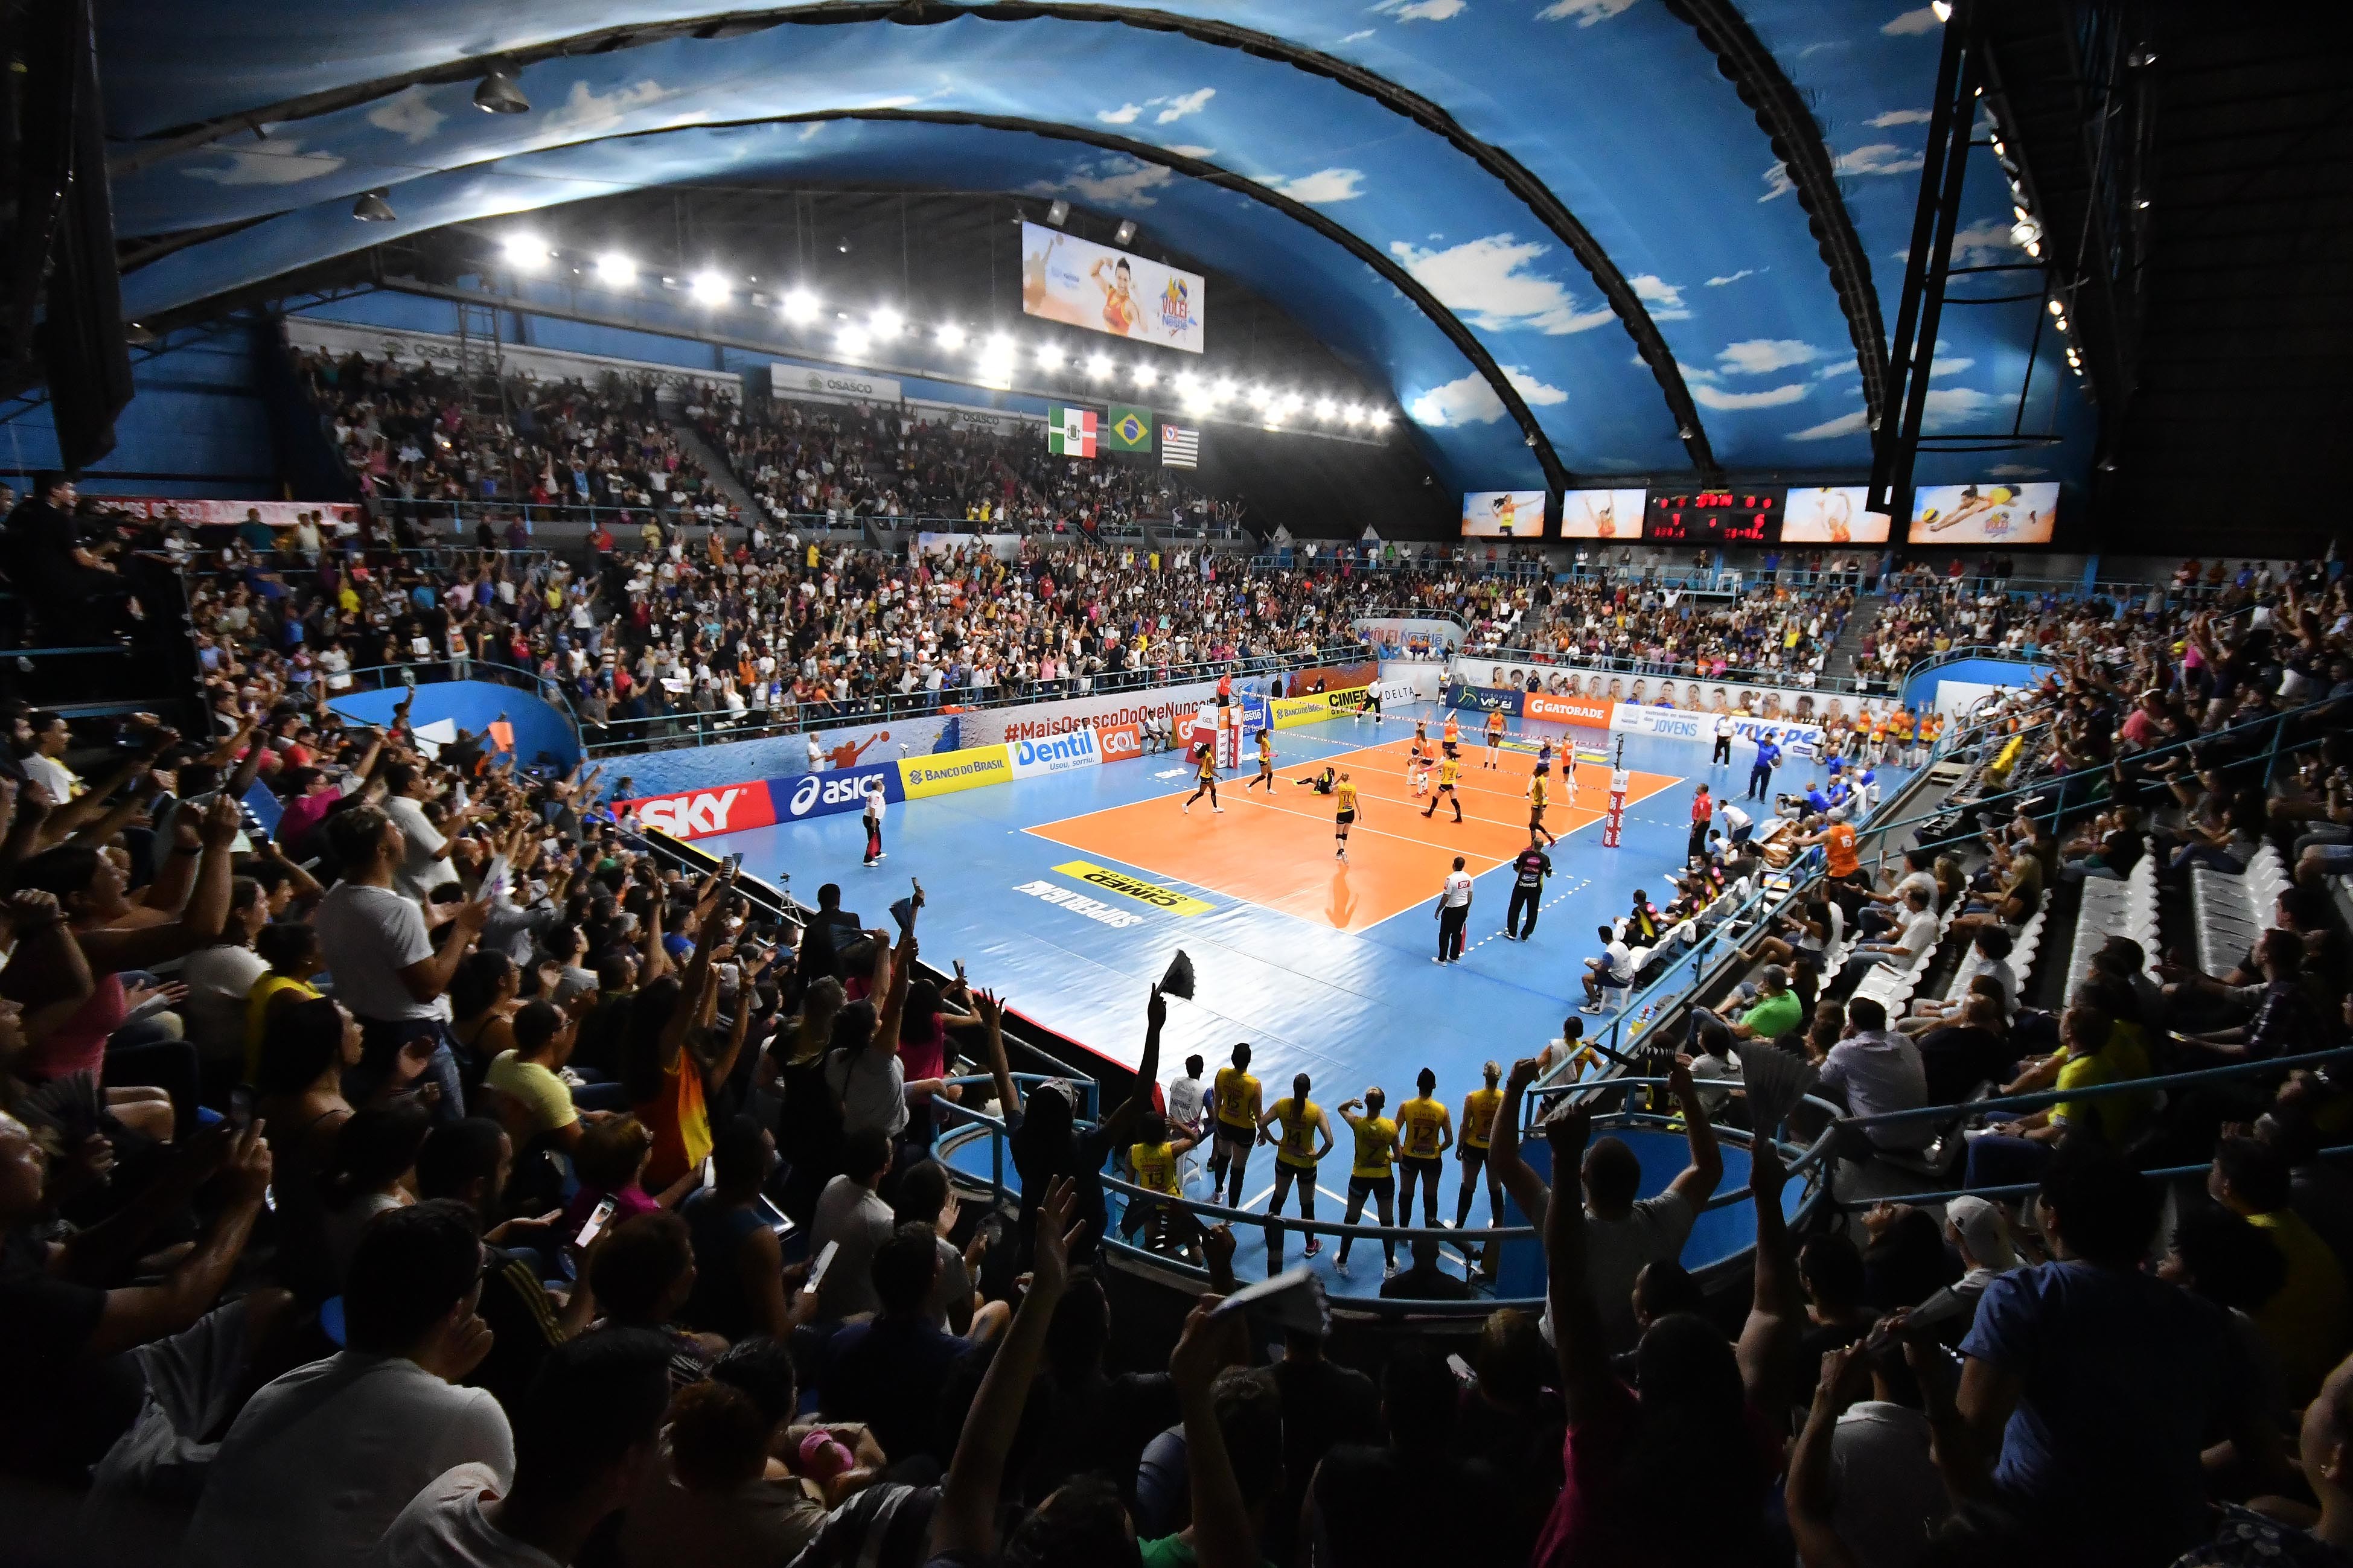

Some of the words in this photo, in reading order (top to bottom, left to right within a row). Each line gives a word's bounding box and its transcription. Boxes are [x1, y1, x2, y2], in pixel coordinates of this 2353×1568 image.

[827, 380, 872, 394] OSASCO
[962, 412, 1000, 425] OSASCO
[1385, 686, 1414, 701] DELTA
[1545, 703, 1604, 719] GATORADE
[1652, 719, 1697, 736] JOVENS
[1017, 731, 1093, 766] Dentil
[1102, 731, 1141, 754] GOL
[925, 768, 960, 781] BANCO
[962, 764, 973, 775] DO
[974, 759, 1004, 773] BRASIL
[1050, 762, 1070, 771] Usou,
[1072, 757, 1095, 766] sorriu.
[640, 788, 741, 838] SKY
[1083, 873, 1178, 907] CIMED
[1458, 881, 1470, 889] SKY
[1019, 880, 1143, 928] SUPERLIGA
[1414, 1126, 1434, 1139] 12
